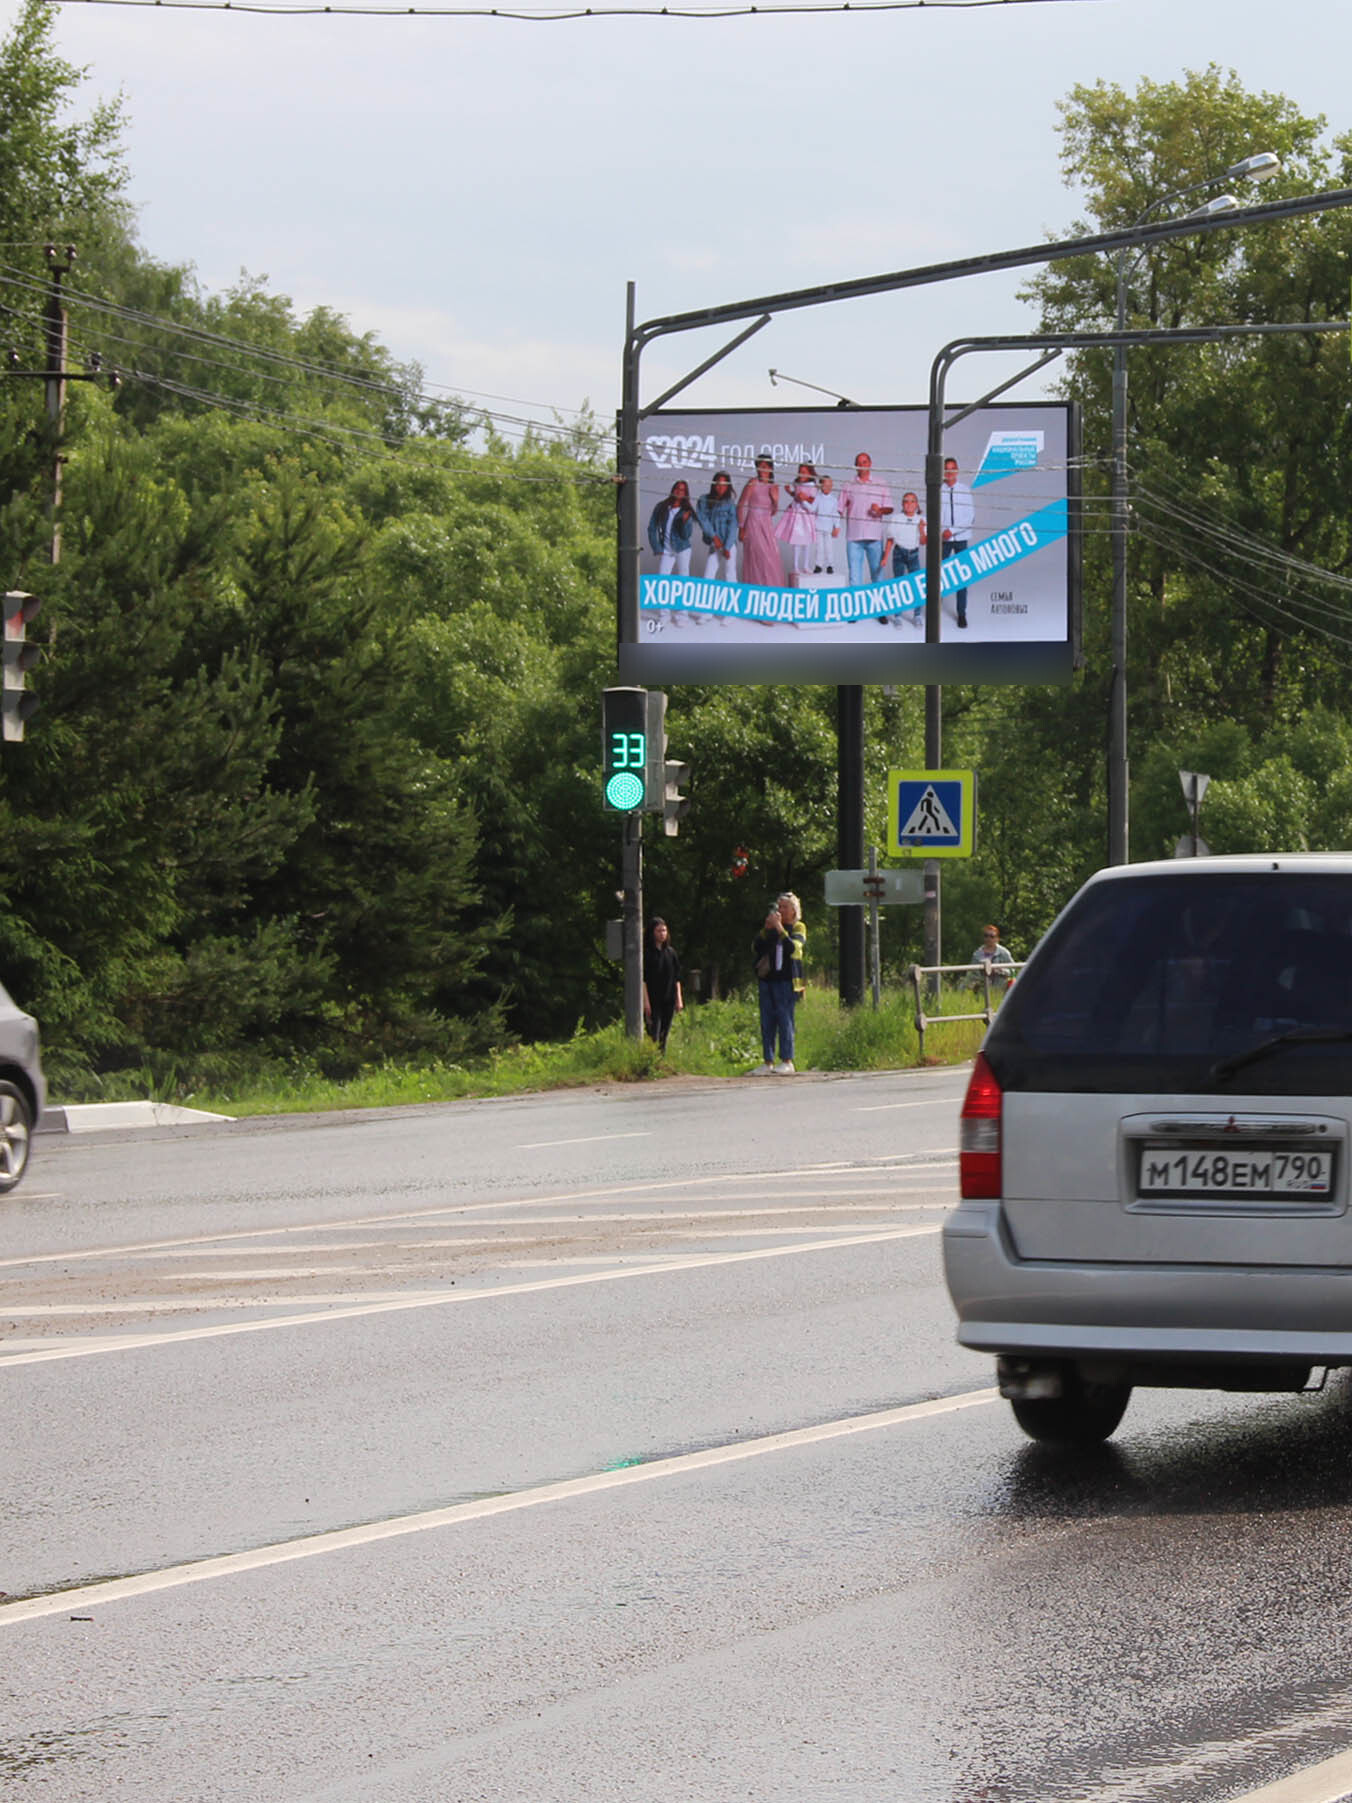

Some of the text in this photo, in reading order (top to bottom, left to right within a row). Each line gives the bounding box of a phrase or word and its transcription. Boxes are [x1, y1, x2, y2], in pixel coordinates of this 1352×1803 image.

[644, 579, 742, 614] ХОРОШИХ
[744, 588, 819, 620] ЛЮДЕЙ
[825, 580, 914, 621] ДОЛЖНО
[969, 522, 1038, 574] МНОГО
[646, 620, 664, 633] 0+
[612, 733, 645, 768] 33
